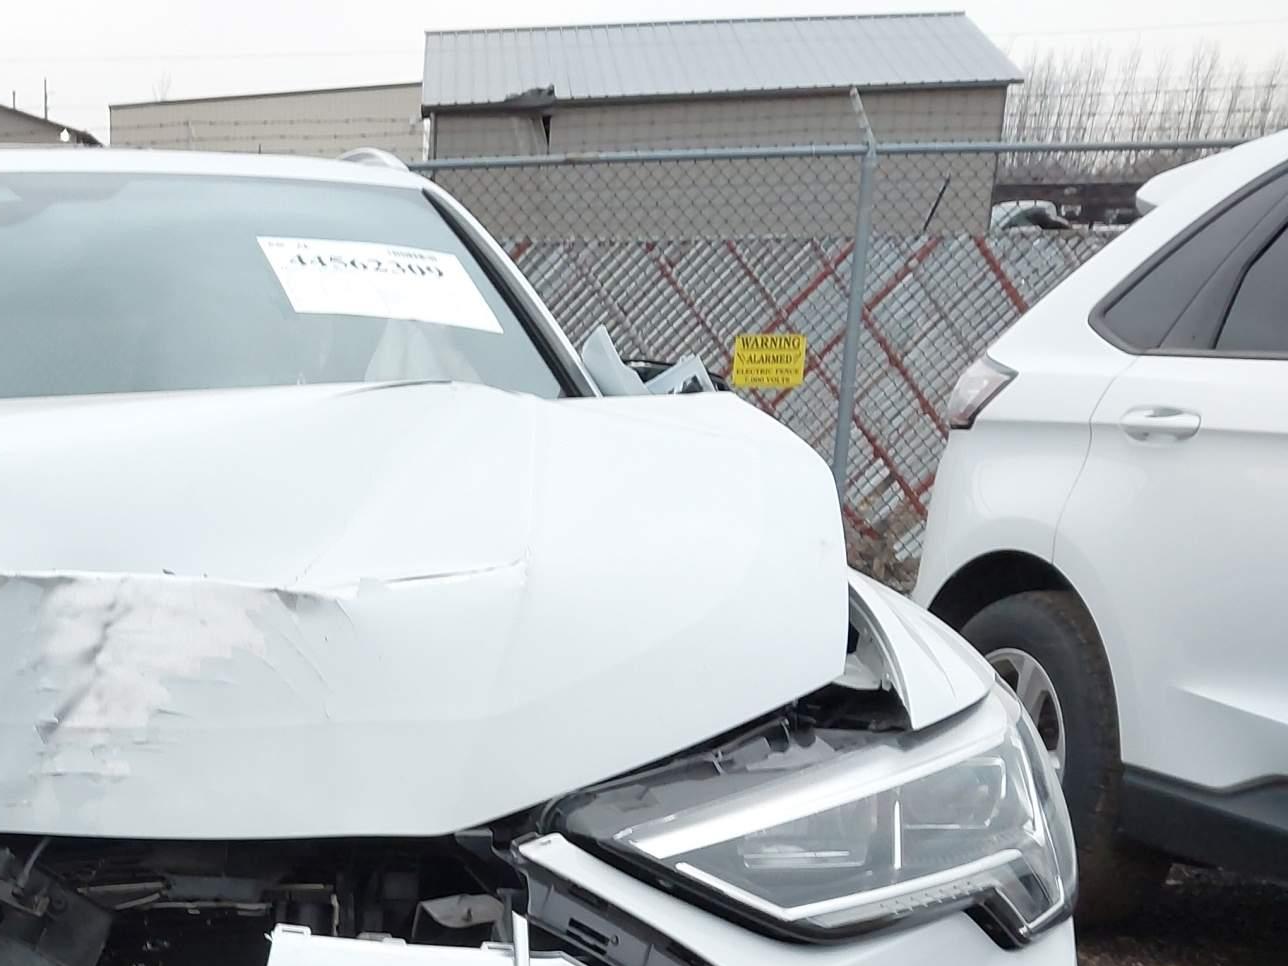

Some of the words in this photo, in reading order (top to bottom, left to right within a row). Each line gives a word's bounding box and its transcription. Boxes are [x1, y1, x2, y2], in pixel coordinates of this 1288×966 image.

[289, 253, 444, 278] 44562309
[741, 336, 801, 350] WARNING
[746, 353, 793, 365] ALARMED
[736, 368, 771, 376] ELECTRIC
[775, 368, 800, 376] FENCE
